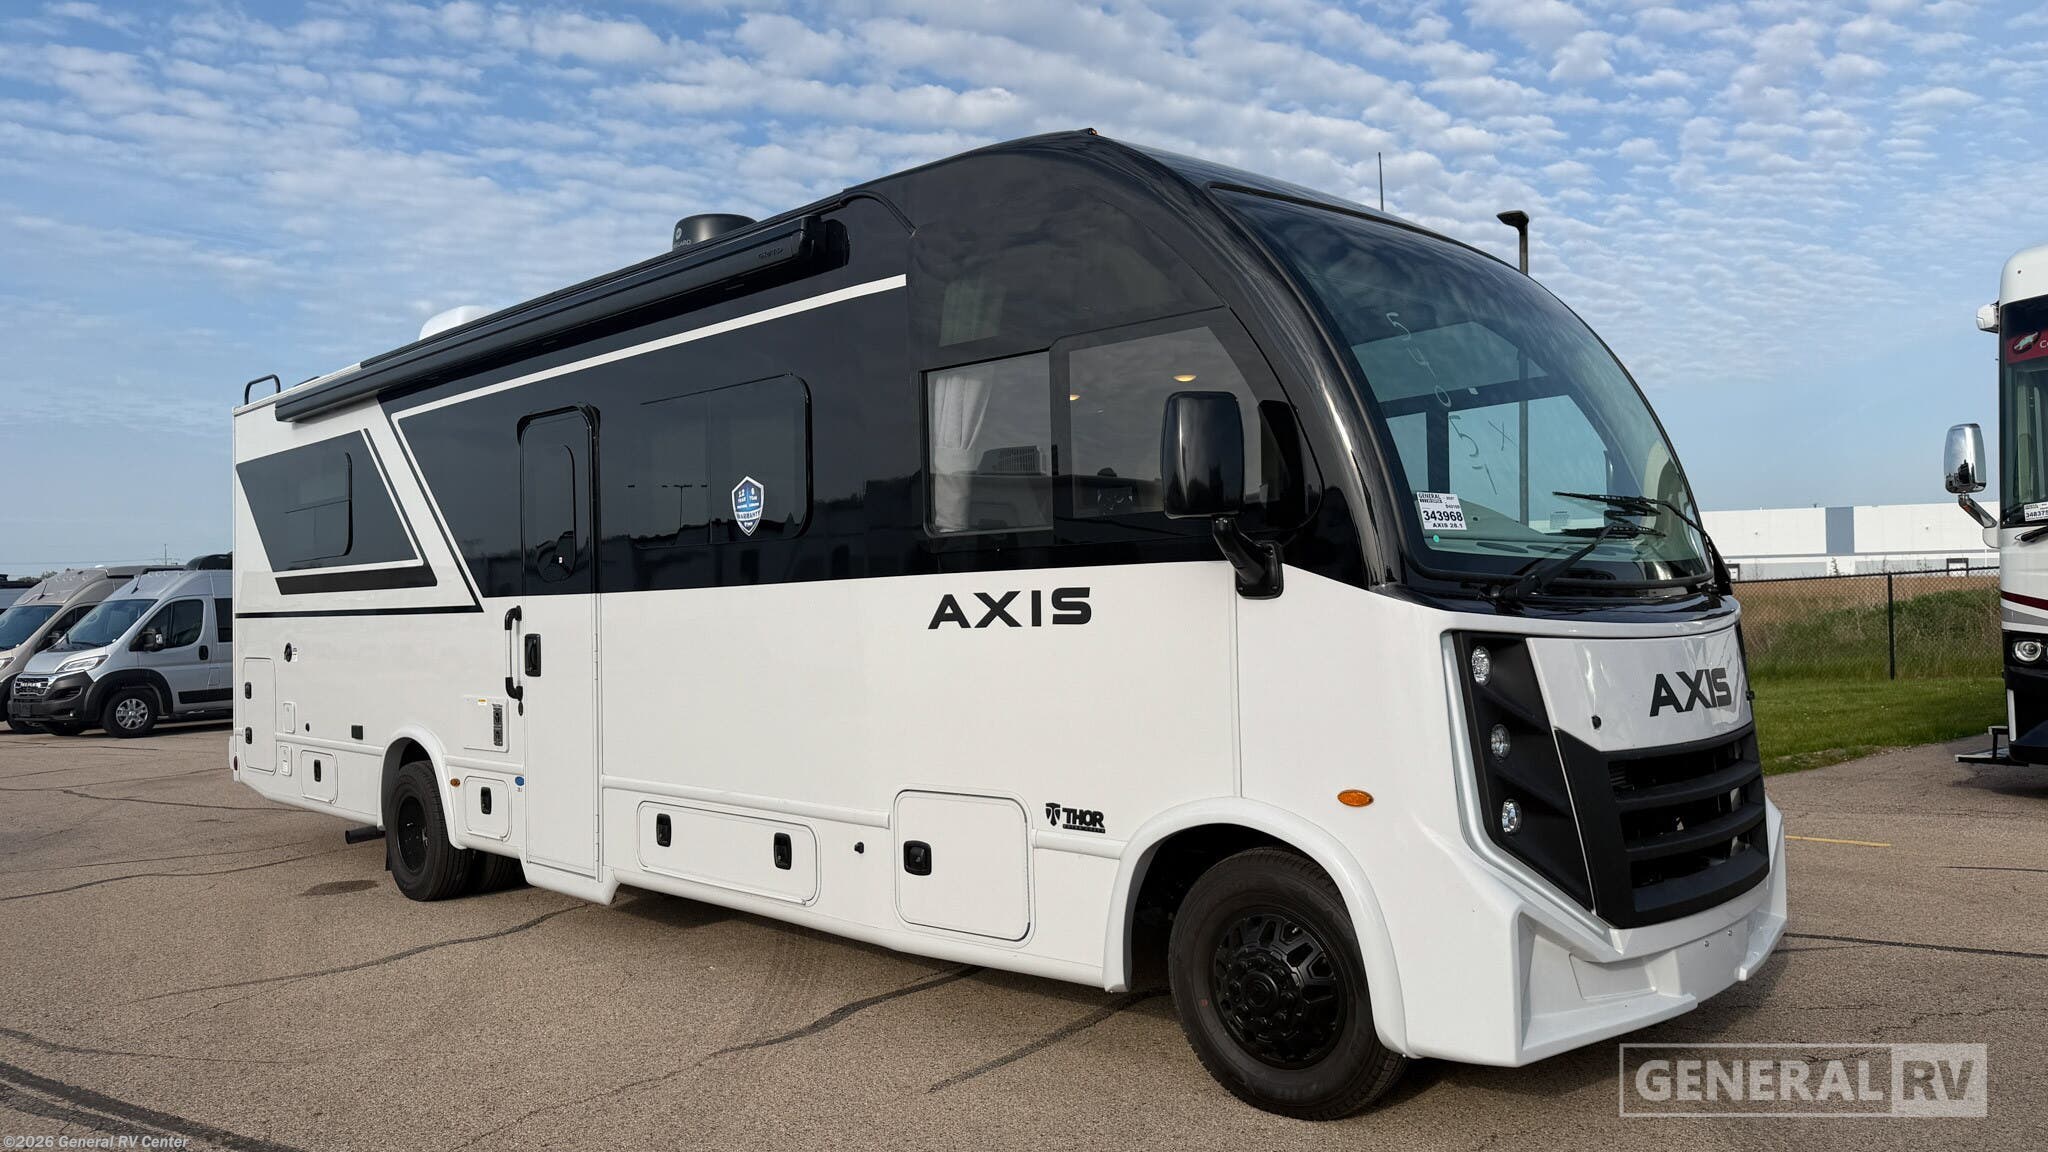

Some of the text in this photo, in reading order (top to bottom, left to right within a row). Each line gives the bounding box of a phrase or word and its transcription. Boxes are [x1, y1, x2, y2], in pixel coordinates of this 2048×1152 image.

[1423, 510, 1463, 522] 343968
[928, 587, 1092, 630] AXIS
[1649, 667, 1732, 717] AXIS
[1062, 807, 1105, 828] THOR
